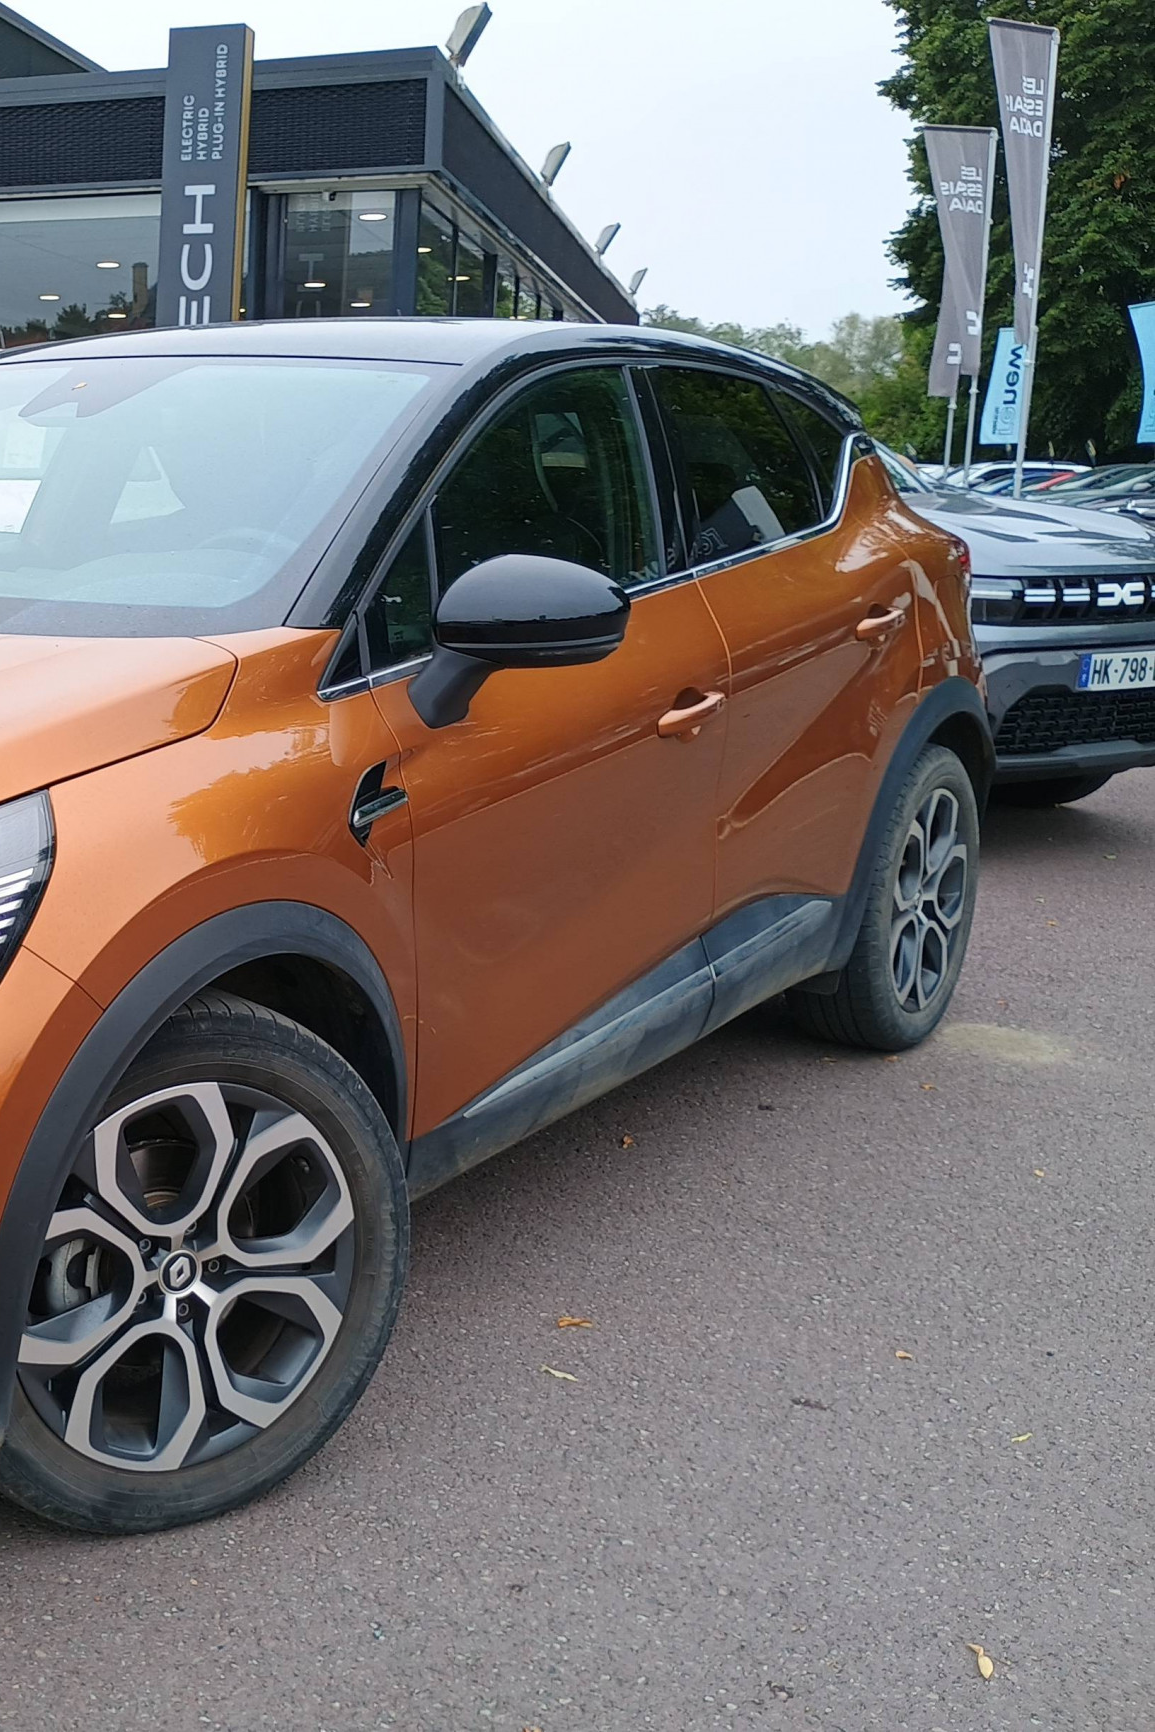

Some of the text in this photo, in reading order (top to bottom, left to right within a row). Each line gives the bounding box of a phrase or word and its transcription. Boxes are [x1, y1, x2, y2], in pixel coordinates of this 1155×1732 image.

[180, 94, 195, 161] ELECTRIC
[211, 44, 228, 160] PLUG-IN HYBRID
[196, 107, 210, 160] HYBRID
[1091, 655, 1155, 685] HK-798-
